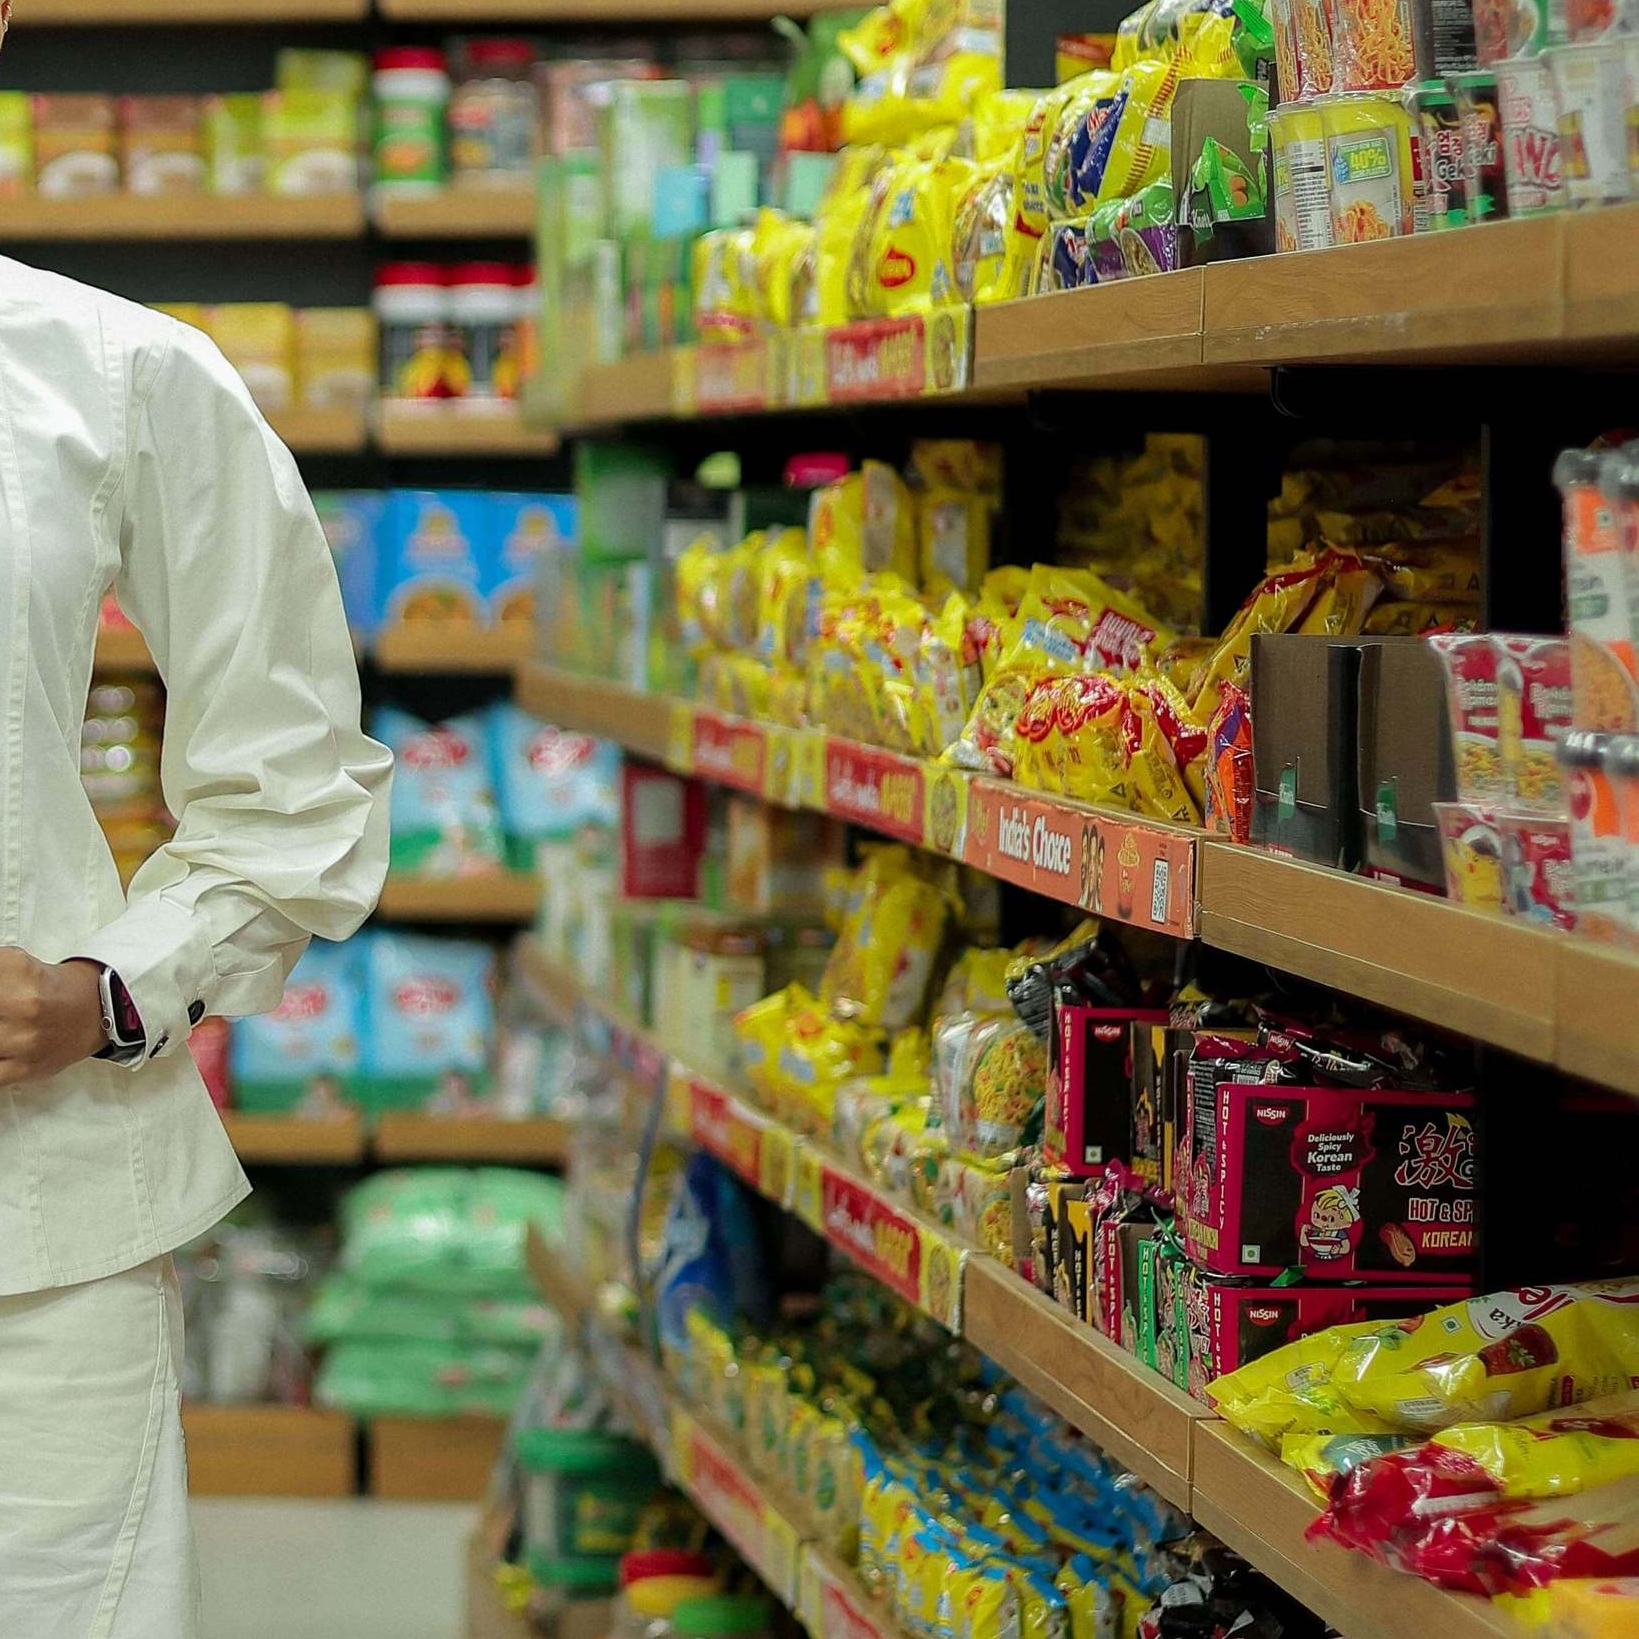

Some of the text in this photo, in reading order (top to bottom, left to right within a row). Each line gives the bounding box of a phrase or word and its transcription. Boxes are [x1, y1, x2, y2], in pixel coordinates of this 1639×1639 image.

[1349, 148, 1387, 172] 40%
[998, 807, 1071, 876] India's Choice
[1222, 1090, 1230, 1137] HOT
[1256, 1107, 1287, 1120] NISSIN
[1307, 1131, 1355, 1144] Deliciously
[1317, 1141, 1342, 1153] Spicy
[1307, 1150, 1353, 1165] Korean
[1316, 1163, 1342, 1173] Taste
[1217, 1157, 1227, 1231] SPICY
[1408, 1197, 1440, 1222] HOT
[1213, 1292, 1221, 1337] HOT
[1249, 1308, 1279, 1320] NISSIN
